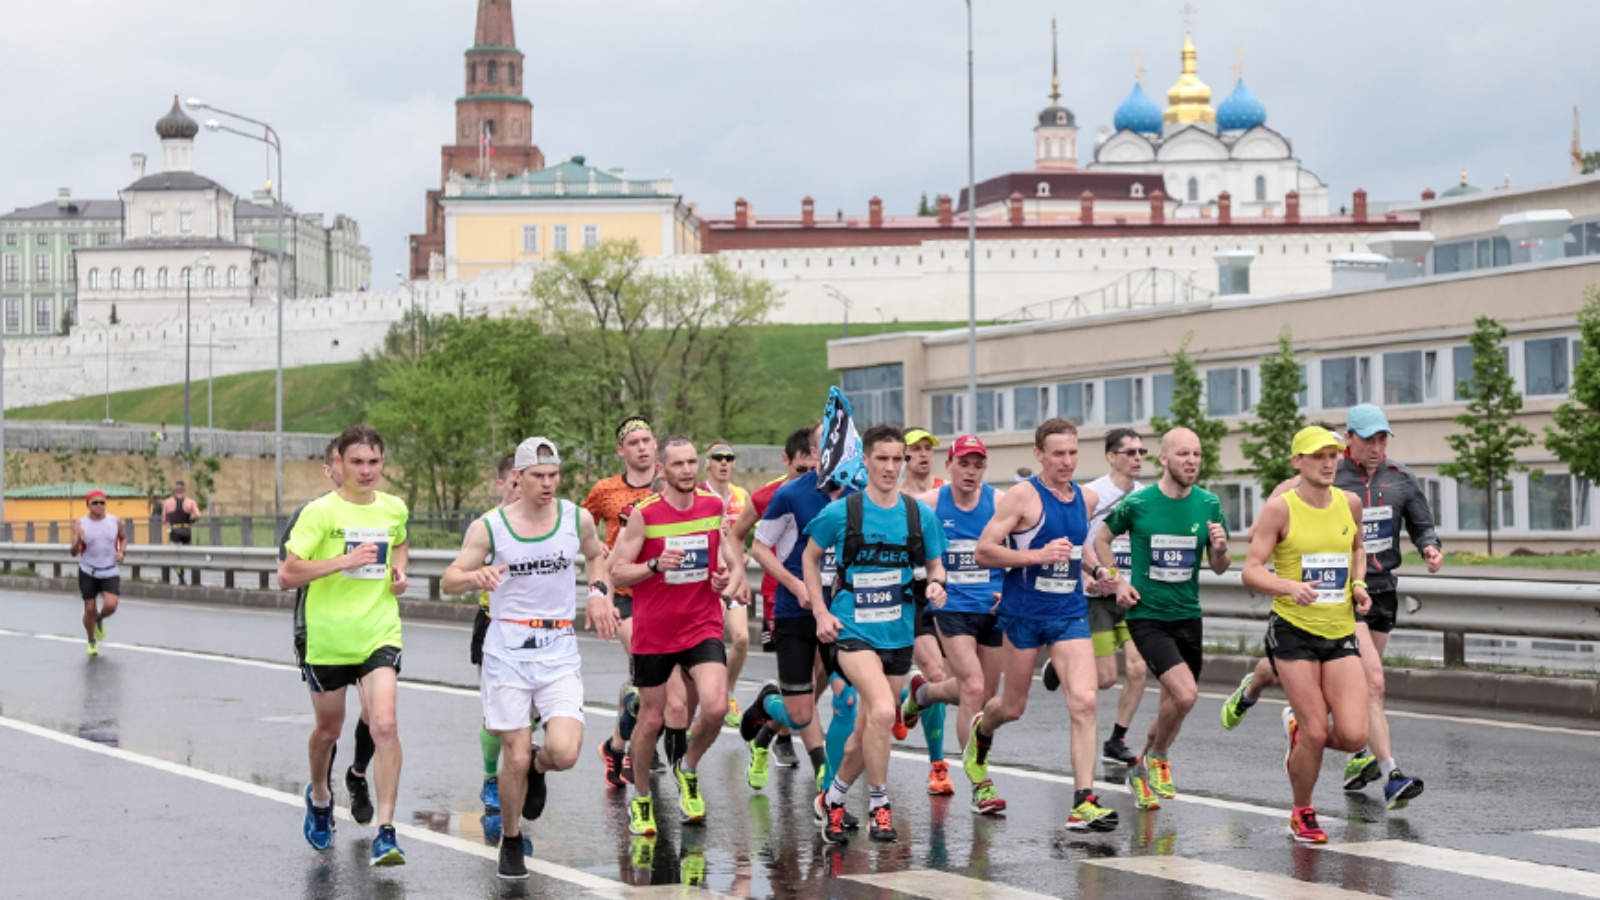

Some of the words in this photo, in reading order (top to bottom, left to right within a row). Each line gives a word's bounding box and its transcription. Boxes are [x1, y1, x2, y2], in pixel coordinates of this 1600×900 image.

[1152, 551, 1159, 560] B
[1163, 551, 1183, 561] 636
[1304, 569, 1312, 580] A
[856, 593, 863, 603] E
[866, 591, 892, 603] 1096
